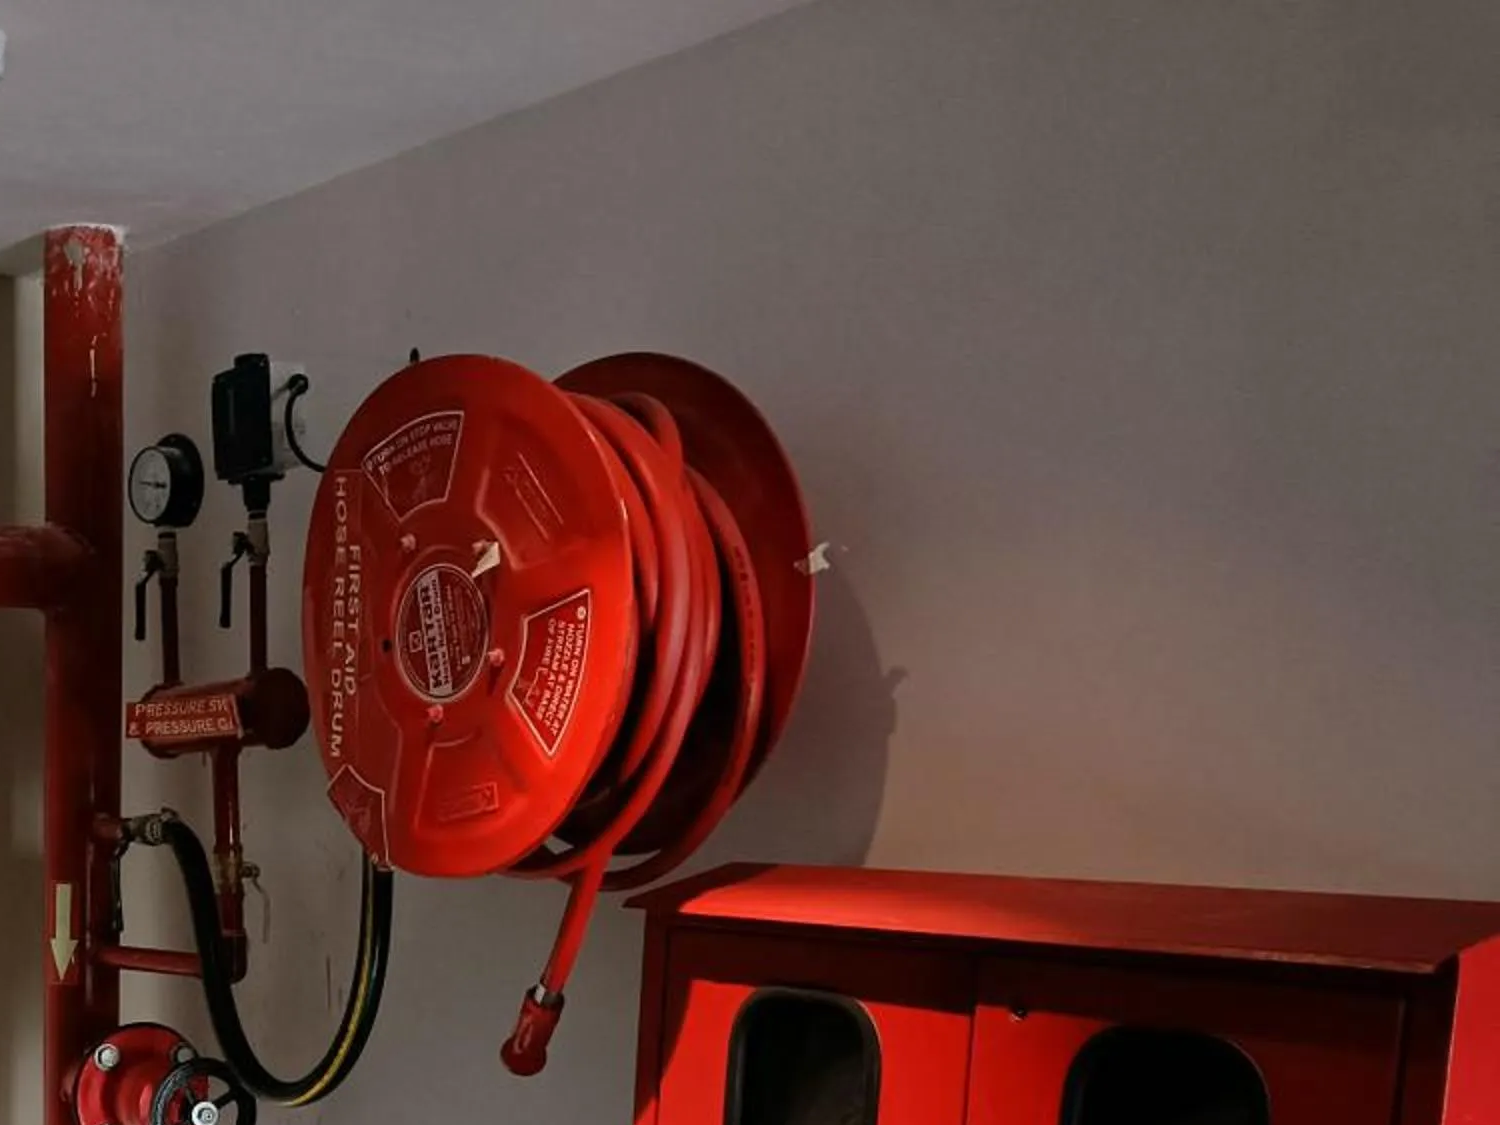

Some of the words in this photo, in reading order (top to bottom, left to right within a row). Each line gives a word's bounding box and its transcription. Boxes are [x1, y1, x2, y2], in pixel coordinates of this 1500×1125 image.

[335, 477, 347, 566] HOSE
[332, 577, 345, 658] REEL
[347, 545, 360, 633] FIRST
[135, 700, 206, 717] PRESSURE
[344, 643, 357, 695] AID
[128, 722, 140, 736] &
[146, 718, 216, 736] PRESSURE
[330, 668, 343, 757] DRUM
